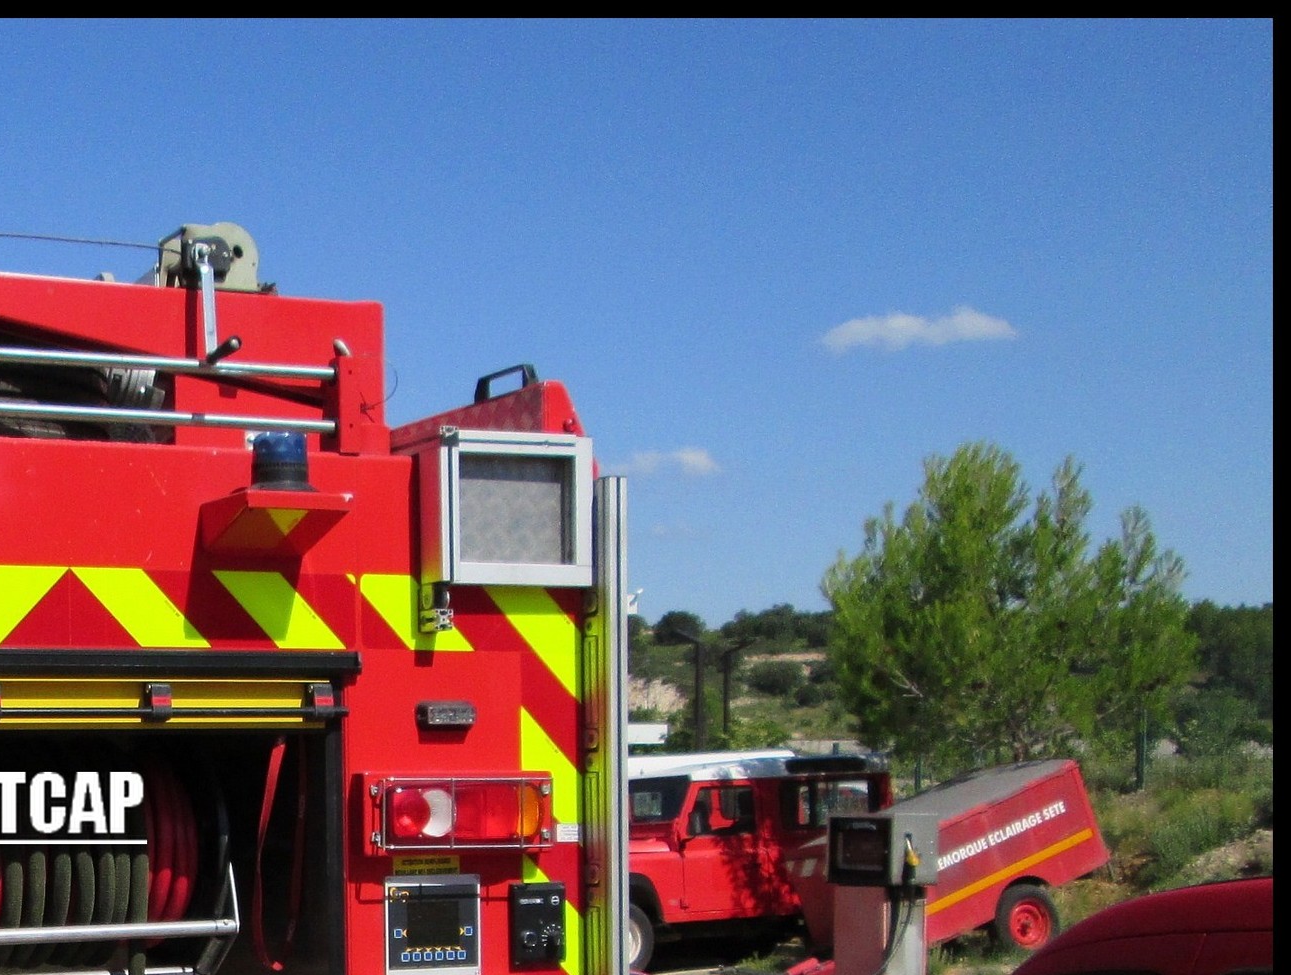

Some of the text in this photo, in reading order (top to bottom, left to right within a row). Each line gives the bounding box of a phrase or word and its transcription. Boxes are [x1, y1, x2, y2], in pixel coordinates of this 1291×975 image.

[937, 802, 1066, 872] EMORQUE ECLAIRAGE SETE
